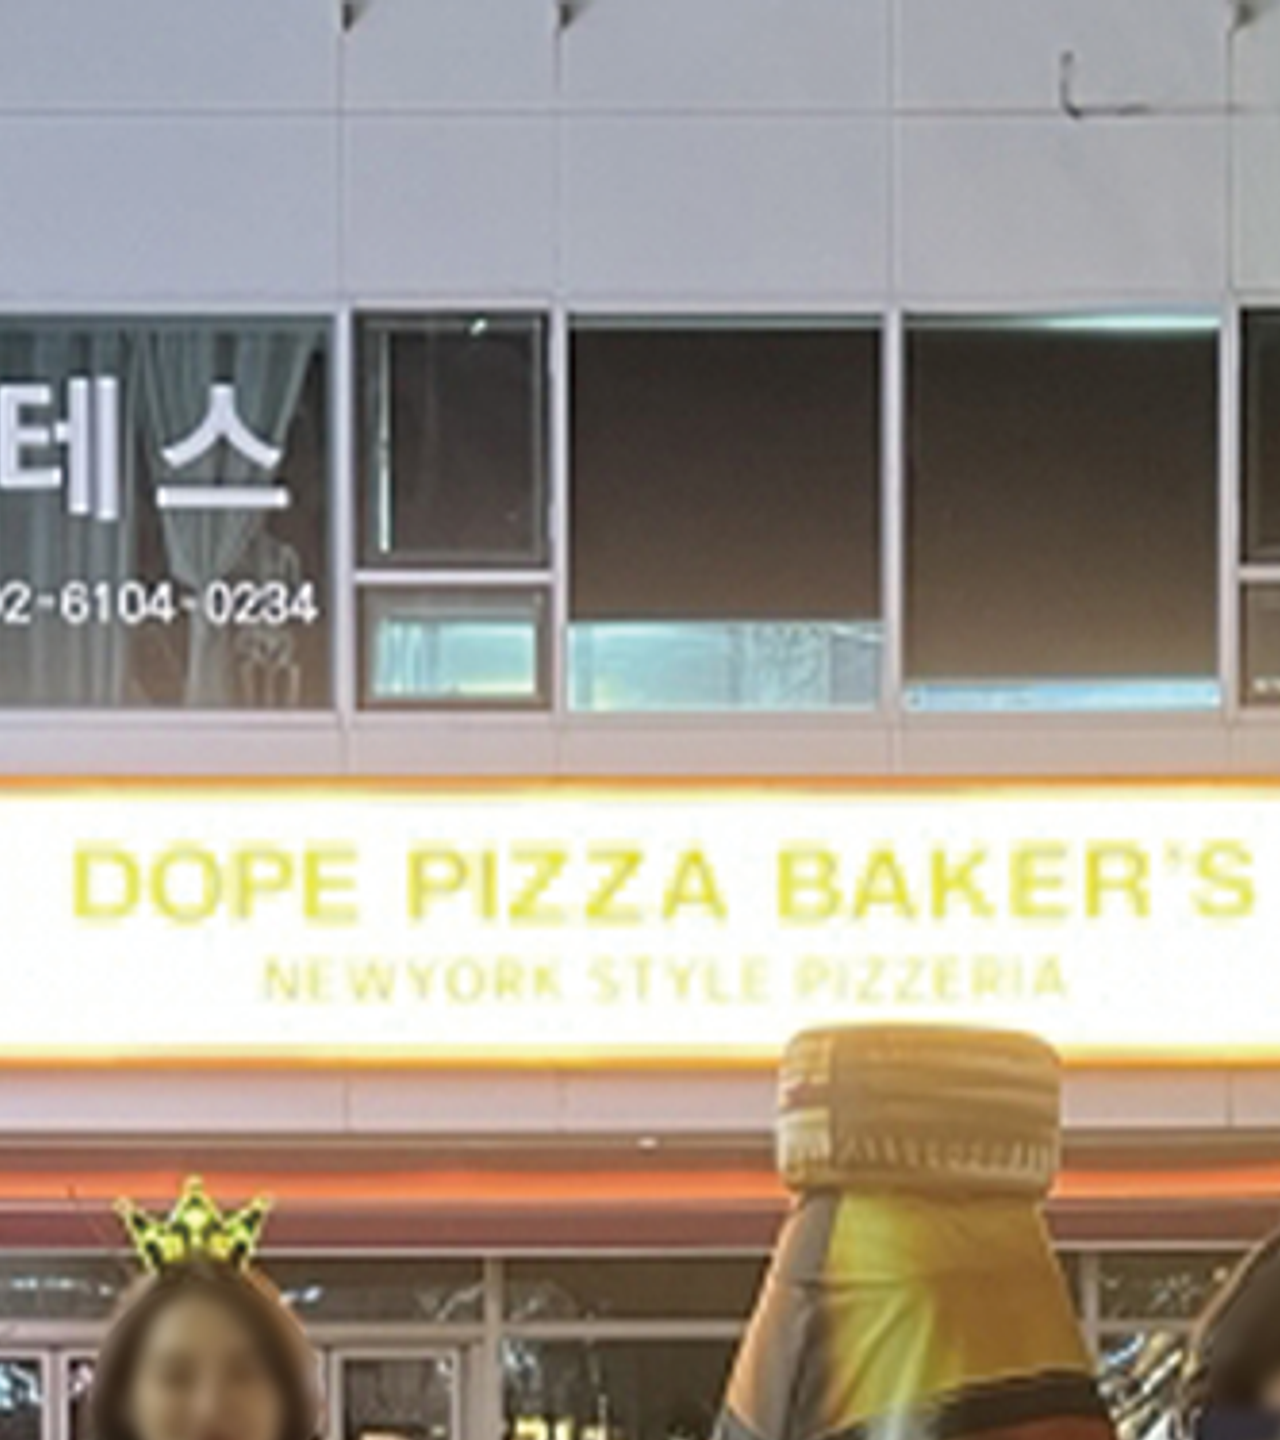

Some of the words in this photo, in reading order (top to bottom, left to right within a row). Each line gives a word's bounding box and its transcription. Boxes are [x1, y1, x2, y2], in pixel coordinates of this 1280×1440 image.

[73, 843, 360, 922] DOPE
[408, 843, 727, 922] PIZZA
[776, 842, 1258, 923] BAKER'S
[263, 956, 561, 1004] NEWYORK
[589, 956, 768, 1004] STYLE
[796, 956, 1068, 1004] PIZZERIA
